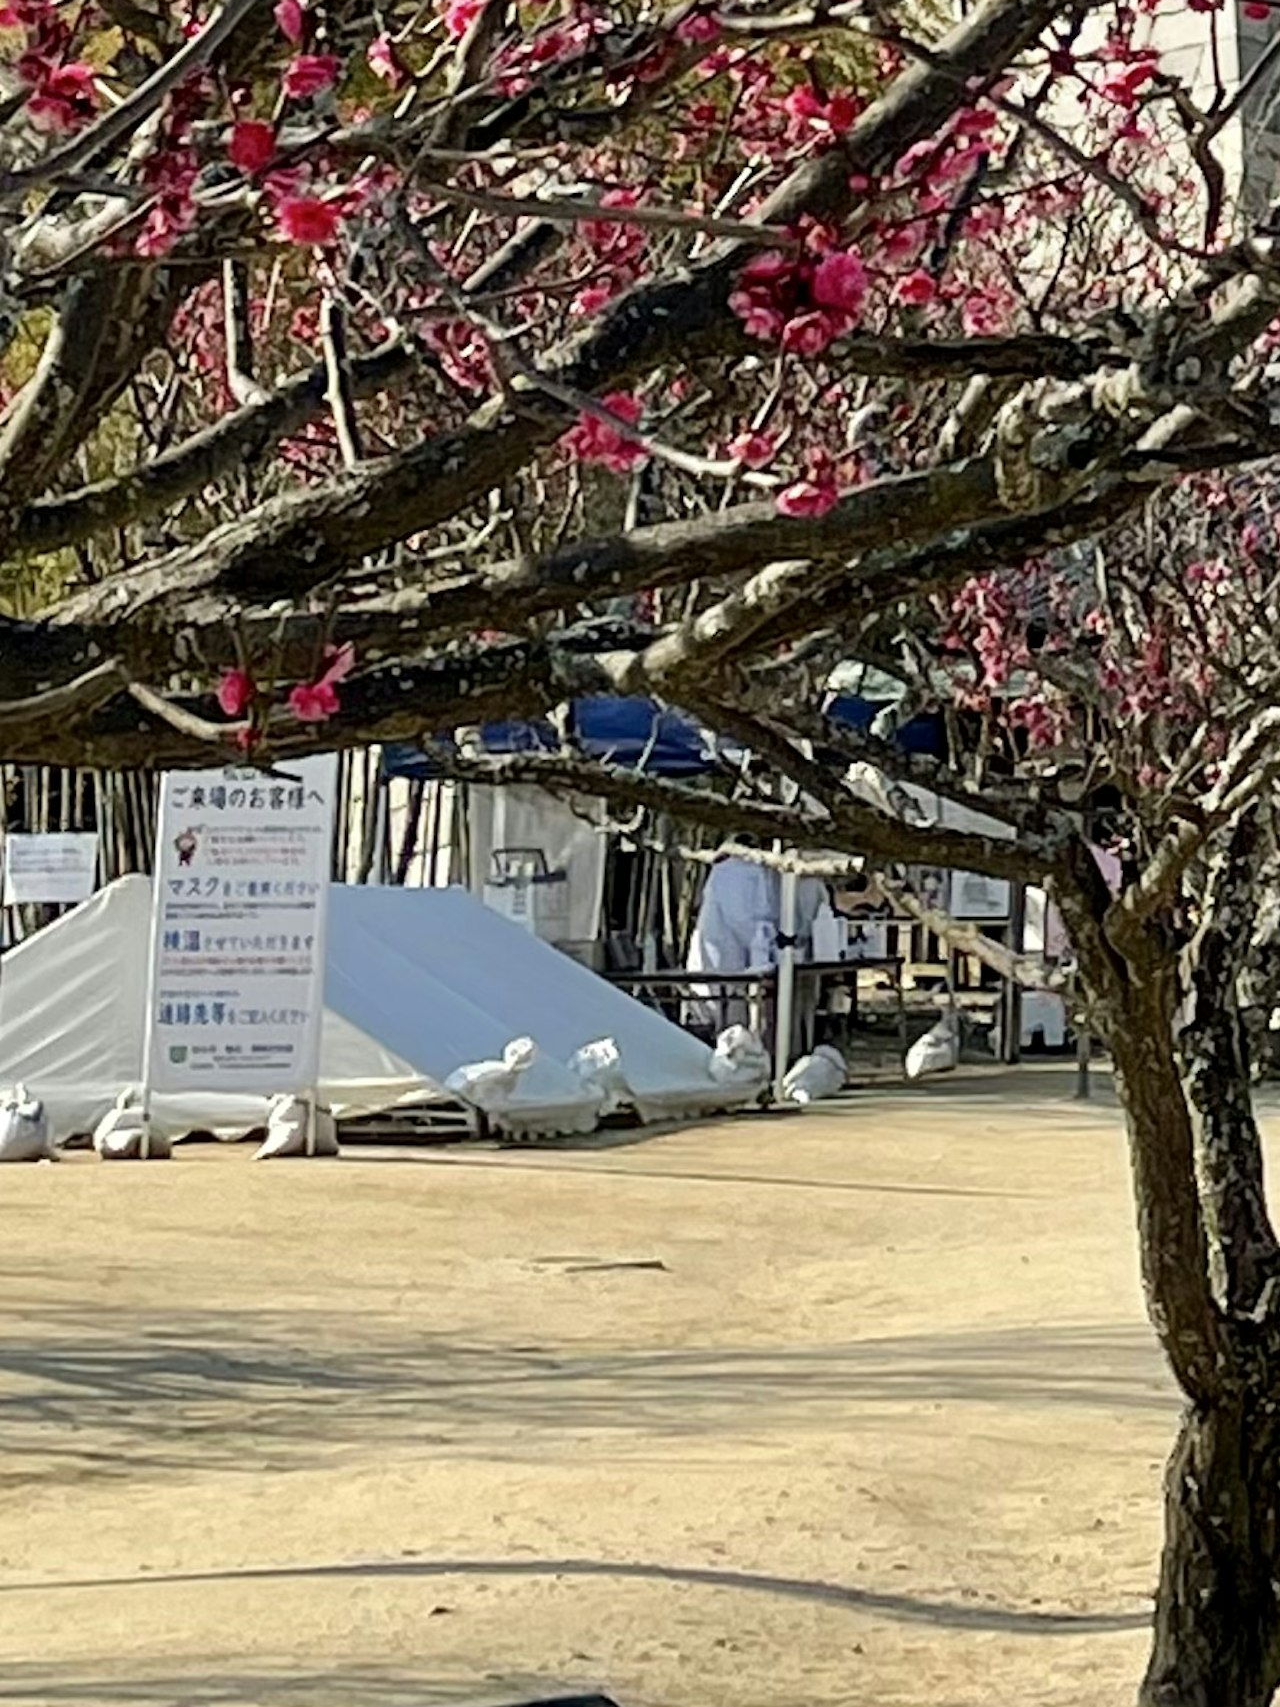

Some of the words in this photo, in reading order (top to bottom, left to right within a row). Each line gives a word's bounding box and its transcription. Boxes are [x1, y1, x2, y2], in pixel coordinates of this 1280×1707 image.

[172, 786, 325, 810] ご来場のお客様へ
